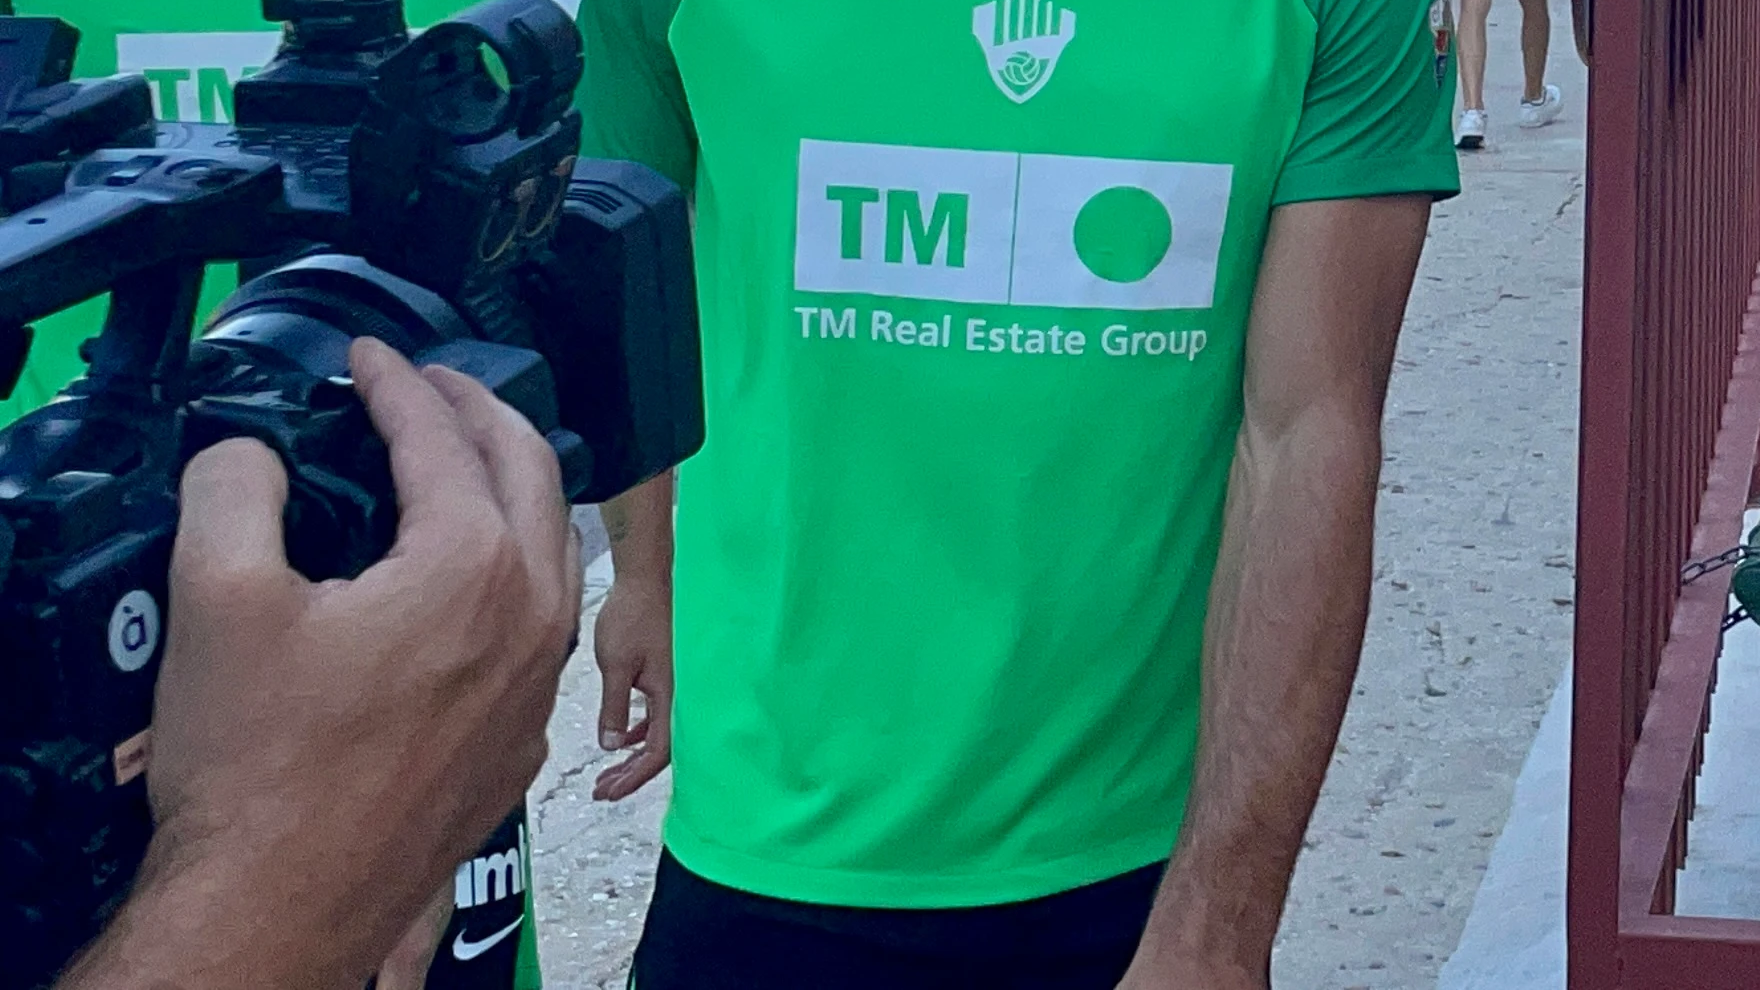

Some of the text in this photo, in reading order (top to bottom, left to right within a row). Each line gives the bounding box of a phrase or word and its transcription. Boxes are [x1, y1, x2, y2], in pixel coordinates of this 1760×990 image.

[826, 185, 969, 269] TM
[794, 307, 1208, 361] TM Real Estate Group
